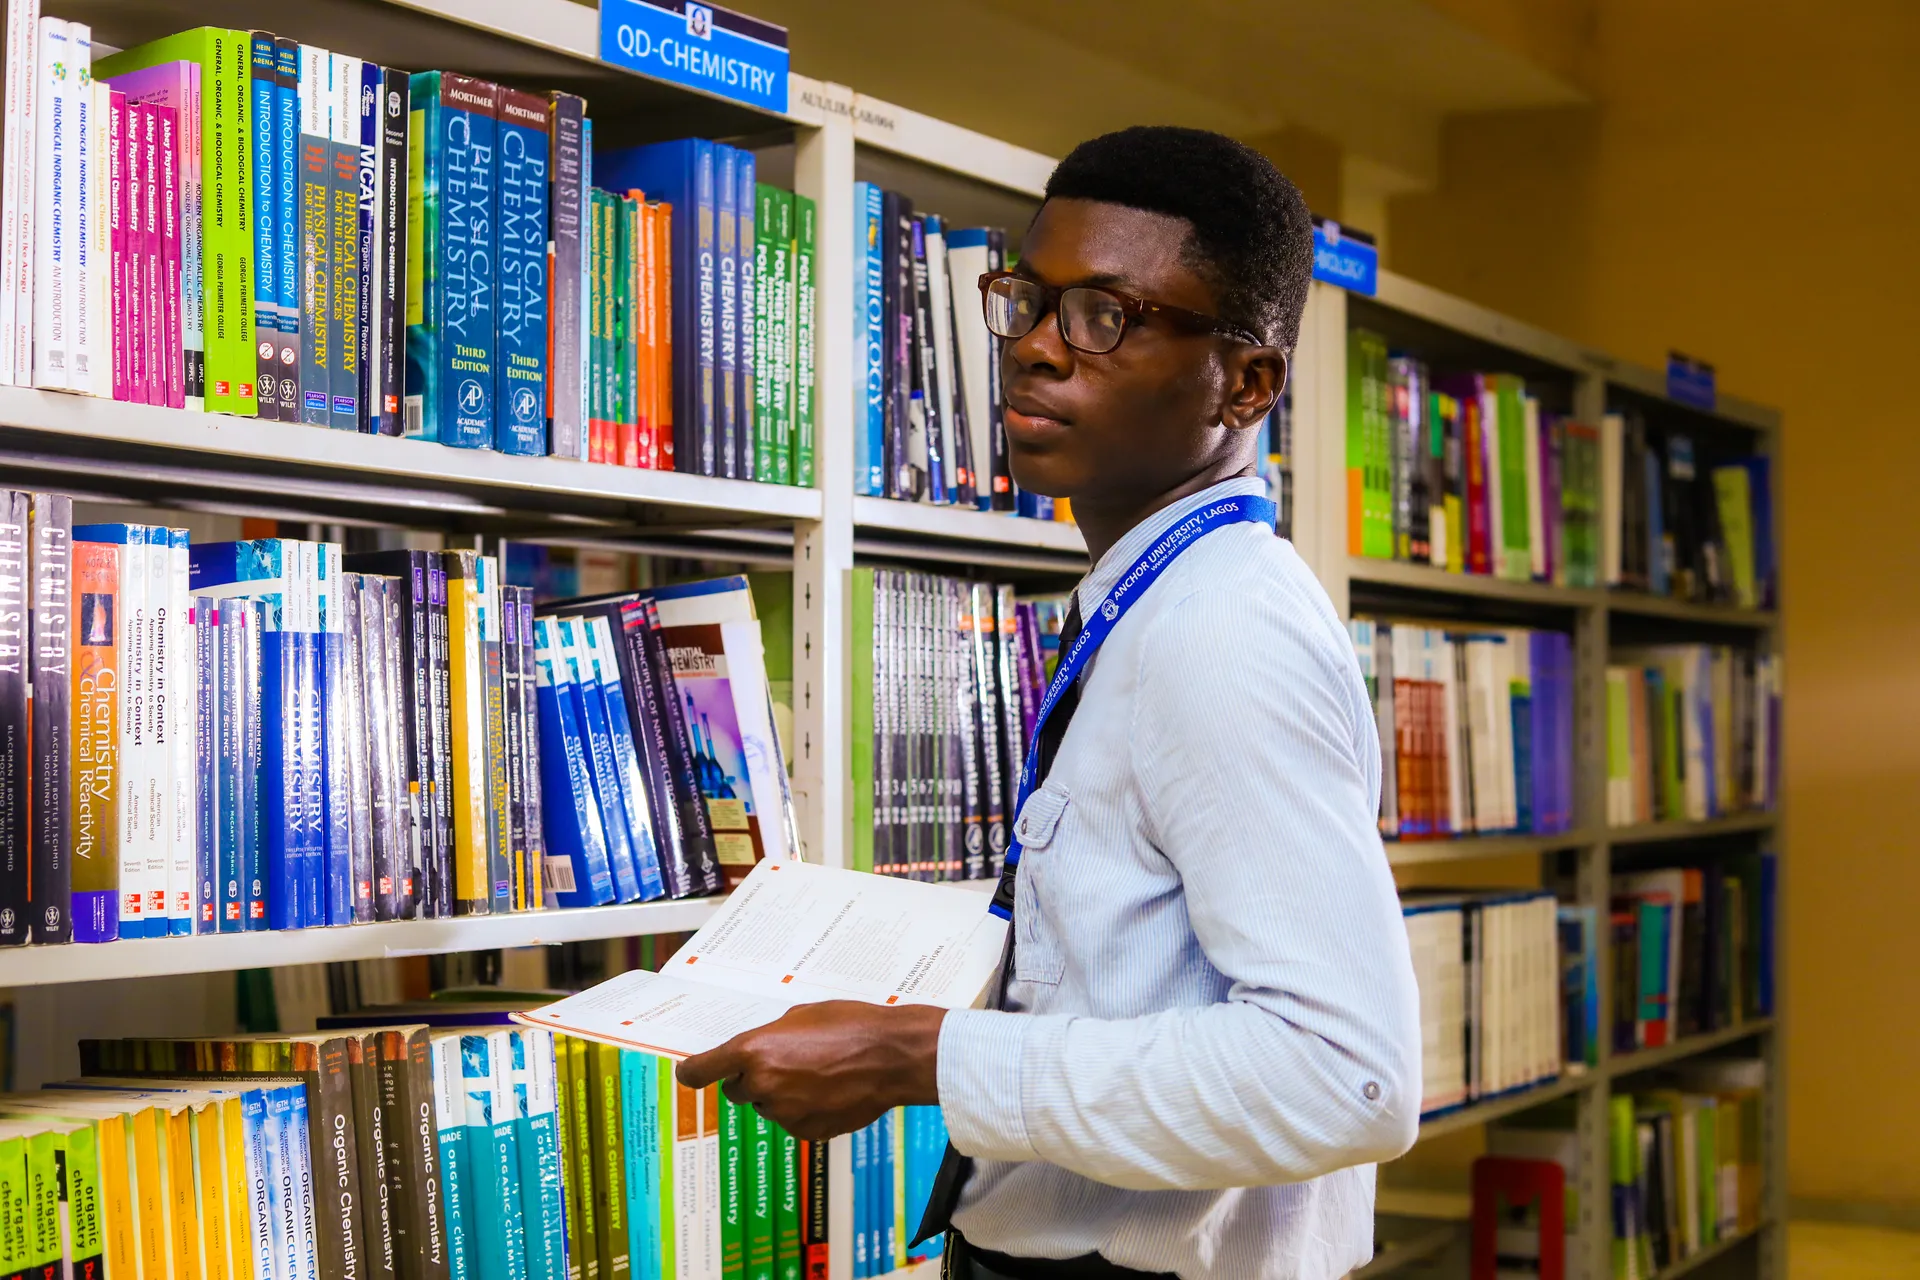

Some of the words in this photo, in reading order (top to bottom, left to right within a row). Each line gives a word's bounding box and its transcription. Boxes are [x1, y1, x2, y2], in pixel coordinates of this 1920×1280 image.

[252, 56, 274, 66] ARENA
[256, 44, 271, 52] HEIN
[276, 65, 296, 75] ARENA
[280, 52, 294, 60] HEIN
[617, 24, 775, 96] QD-CHEMISTRY
[53, 96, 62, 152] BIOLOGICAL
[110, 106, 120, 138] Abbey
[129, 110, 138, 142] Abbey
[146, 112, 154, 146] Abbey
[450, 88, 494, 108] MORTIMER
[504, 103, 546, 123] MORTIMER
[110, 139, 120, 179] Physical
[129, 142, 138, 181] Physical
[146, 144, 155, 182] Physical
[163, 118, 171, 150] Abbey
[259, 90, 272, 196] INTRODUCTION
[282, 98, 294, 204] INTRODUCTION
[52, 154, 62, 206] INORGANIC
[164, 150, 172, 188] Physical
[360, 144, 375, 216] MCAT
[388, 158, 397, 230] INTRODUCTION
[560, 116, 579, 240] CHEMISTRY
[111, 180, 120, 230] Chemistry
[130, 182, 139, 232] Chemistry
[148, 183, 156, 234] Chemistry
[166, 190, 174, 240] Chemistry
[238, 187, 246, 232] CHEMISTRY
[261, 200, 270, 212] to
[314, 184, 326, 266] PHYSICAL
[334, 190, 342, 214] FOR
[334, 216, 342, 236] THE
[344, 192, 356, 274] PHYSICAL
[448, 116, 467, 338] CHEMISTRY
[470, 142, 492, 318] PHYSICAL
[52, 208, 62, 262] CHEMISTRY
[260, 216, 272, 294] CHEMISTRY
[283, 222, 294, 299] CHEMISTRY
[334, 238, 342, 262] LIFE
[361, 235, 369, 272] Organic
[502, 130, 525, 347] CHEMISTRY
[524, 155, 545, 328] PHYSICAL
[334, 266, 342, 321] SCIENCES
[361, 274, 370, 324] Chemistry
[388, 246, 396, 301] CHEMISTRY
[756, 244, 767, 315] POLYMER
[774, 250, 785, 320] POLYMER
[799, 254, 809, 326] POLYMER
[52, 280, 62, 342] INTRODUCTION
[314, 270, 327, 369] CHEMISTRY
[344, 277, 356, 374] CHEMISTRY
[700, 252, 714, 362] CHEMISTRY
[721, 257, 736, 366] CHEMISTRY
[742, 261, 755, 370] CHEMISTRY
[361, 326, 369, 361] Review
[452, 358, 490, 374] EDITION
[456, 344, 486, 358] THIRD
[506, 366, 542, 382] EDITION
[510, 353, 539, 368] THIRD
[756, 318, 767, 408] CHEMISTRY
[773, 323, 785, 411] CHEMISTRY
[798, 326, 809, 415] CHEMISTRY
[456, 416, 487, 428] ACADEMIC
[463, 425, 480, 435] PRESS
[1114, 560, 1150, 600] ANCHOR
[1148, 514, 1204, 564] UNIVERSITY,
[1204, 502, 1239, 520] LAGOS
[1150, 526, 1202, 572] www.aul.edu.ng
[40, 526, 66, 675] CHEMISTRY
[134, 608, 144, 676] Chemistry
[157, 608, 166, 674] Chemistry
[1068, 629, 1092, 664] LAGOS
[136, 680, 143, 692] in
[418, 668, 426, 704] Organic
[634, 632, 655, 700] PRINCIPLES
[652, 718, 666, 752] NMR
[79, 678, 94, 762] Chemical
[90, 667, 116, 802] Chemistry
[134, 696, 143, 748] Context
[156, 694, 165, 744] Context
[436, 708, 444, 754] Structural
[420, 755, 429, 818] Spectroscopy
[436, 756, 445, 818] Spectroscopy
[512, 756, 520, 803] Chemistry
[566, 736, 586, 812] CHEMISTRY
[592, 732, 612, 809] CHEMISTRY
[598, 733, 618, 804] QUANTUM
[76, 769, 95, 860] Reactivity
[840, 898, 856, 917] FORM
[896, 980, 908, 992] WHY
[906, 954, 928, 980] COVALENT
[905, 960, 934, 994] COMPOUNDS
[930, 945, 944, 961] FORM
[530, 1117, 548, 1130] WADE
[577, 1078, 588, 1150] ORGANIC
[605, 1074, 616, 1146] ORGANIC
[640, 1065, 649, 1121] Pharmaceutical
[333, 1114, 349, 1188] Organic
[420, 1102, 434, 1174] Organic
[440, 1130, 462, 1145] WADE
[494, 1124, 512, 1138] WADE
[374, 1106, 385, 1179] Organic
[380, 1182, 394, 1272] Chemistry
[448, 1148, 461, 1219] ORGANIC
[500, 1142, 511, 1214] ORGANIC
[582, 1154, 594, 1234] CHEMISTRY
[608, 1150, 621, 1230] CHEMISTRY
[726, 1146, 739, 1225] Chemistry
[756, 1140, 769, 1219] Chemistry
[783, 1135, 796, 1212] Chemistry
[1, 1180, 13, 1263] chemistry
[13, 1198, 26, 1259] organic
[34, 1173, 46, 1254] chemistry
[46, 1190, 57, 1251] organic
[73, 1170, 86, 1250] chemistry
[85, 1186, 98, 1246] organic
[340, 1192, 357, 1280] Chemistry
[426, 1177, 441, 1265] Chemistry
